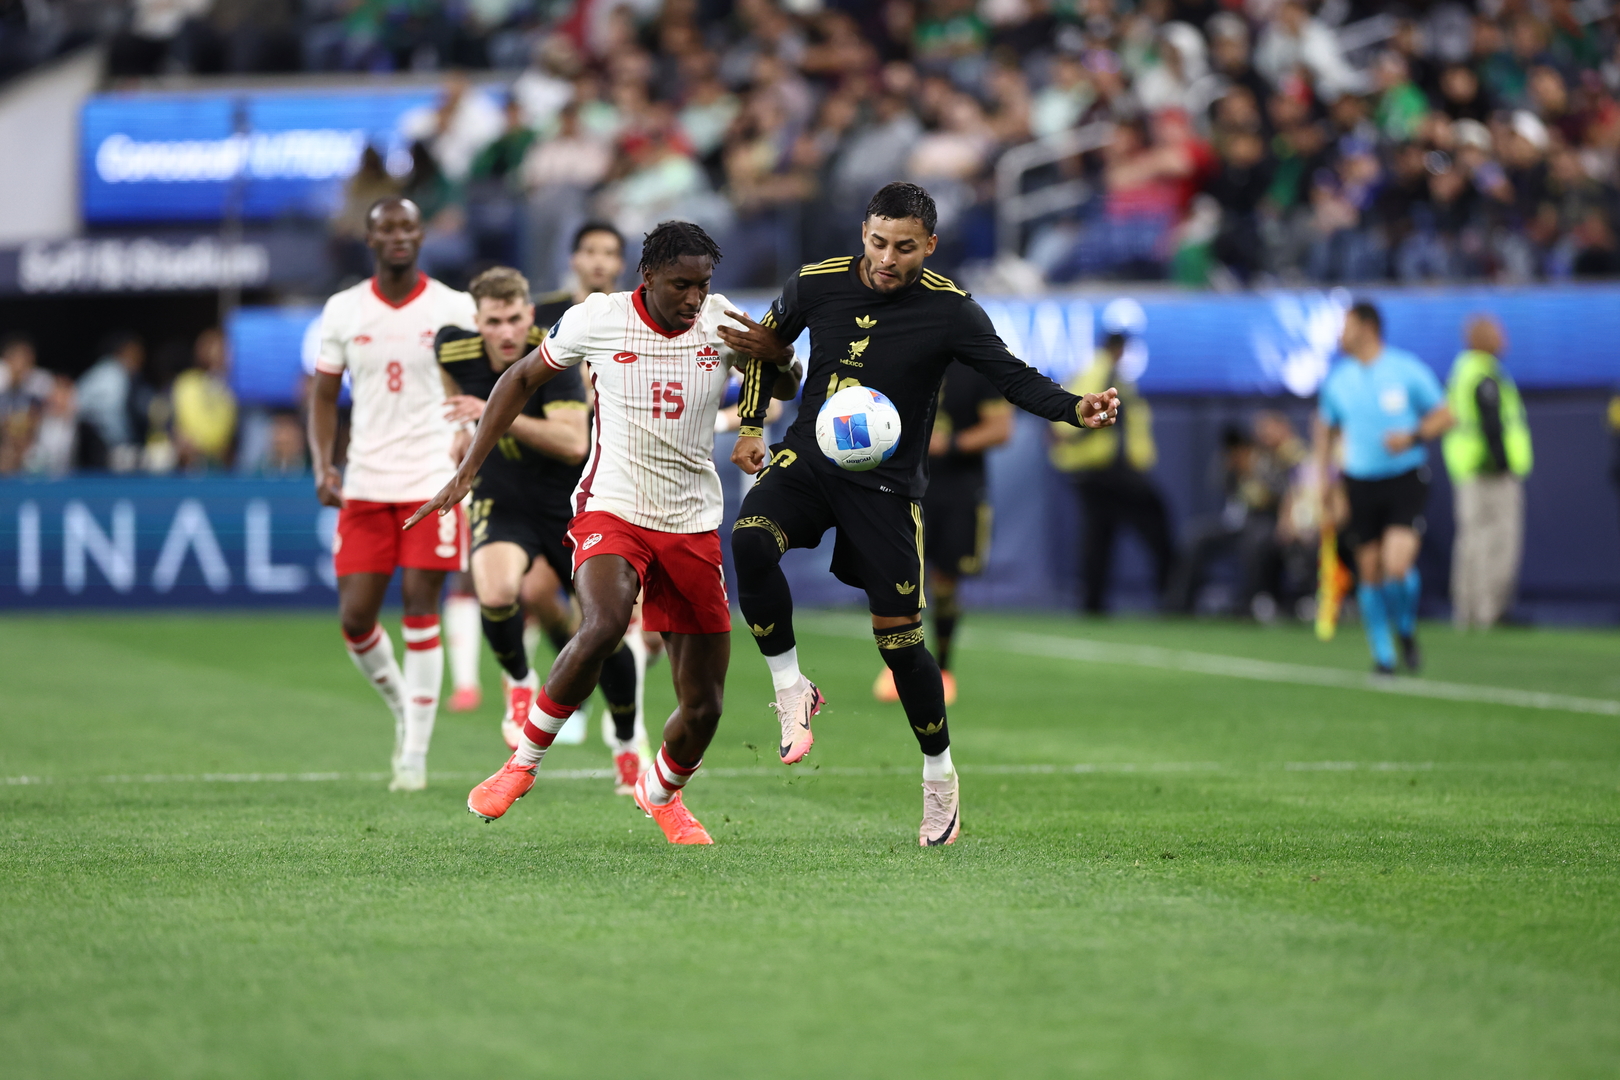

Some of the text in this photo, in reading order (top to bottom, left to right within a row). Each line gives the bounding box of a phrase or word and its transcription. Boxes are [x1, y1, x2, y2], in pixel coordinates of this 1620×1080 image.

[386, 361, 404, 392] 8
[839, 358, 864, 368] MÉXICO
[650, 381, 685, 419] 15
[826, 373, 862, 400] 1
[846, 456, 871, 464] molten
[17, 498, 337, 594] INAL
